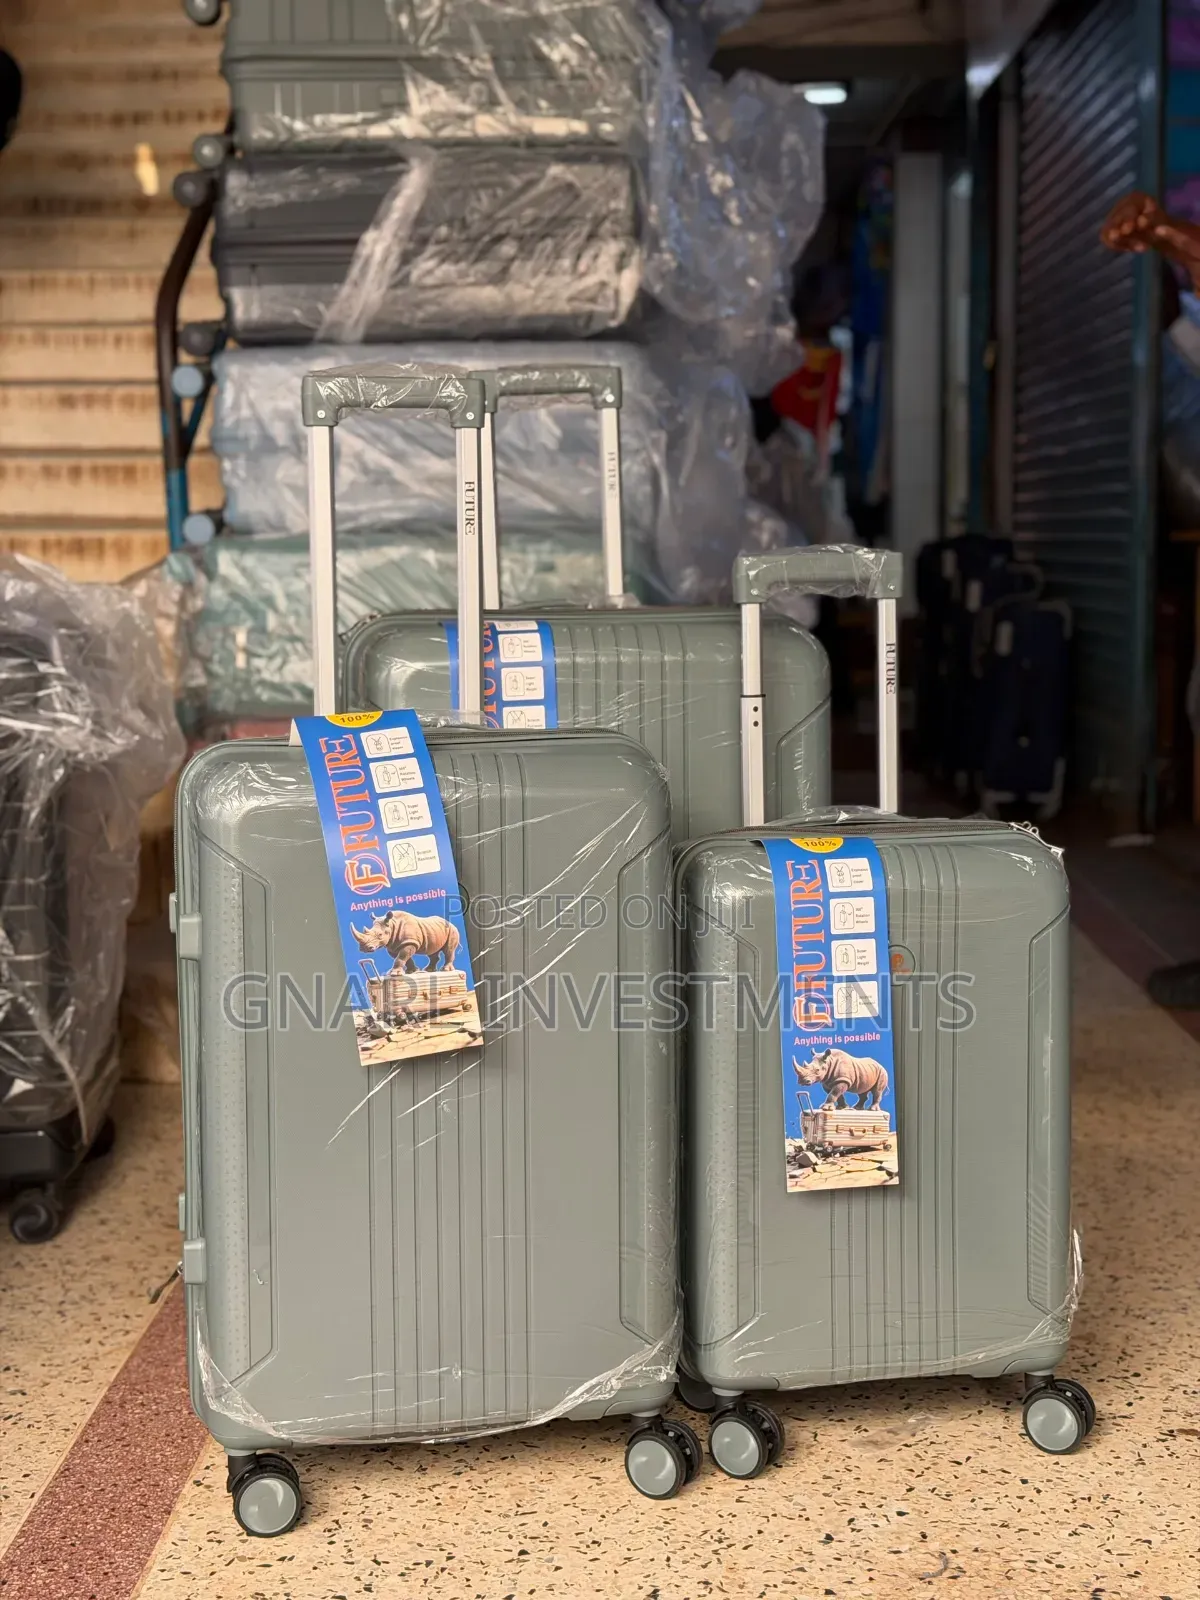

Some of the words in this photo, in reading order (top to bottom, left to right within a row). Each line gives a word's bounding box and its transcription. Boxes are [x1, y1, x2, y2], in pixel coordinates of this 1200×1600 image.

[464, 480, 476, 536] FUTURE
[885, 643, 896, 695] FUTURE
[340, 713, 375, 723] 100%
[319, 733, 380, 856] FUTURE
[350, 895, 393, 912] Anything
[394, 895, 405, 906] is
[406, 888, 446, 905] possible
[786, 859, 827, 993] FUTURE
[793, 1036, 832, 1046] Anything
[834, 1035, 843, 1044] is
[844, 1033, 881, 1045] possible
